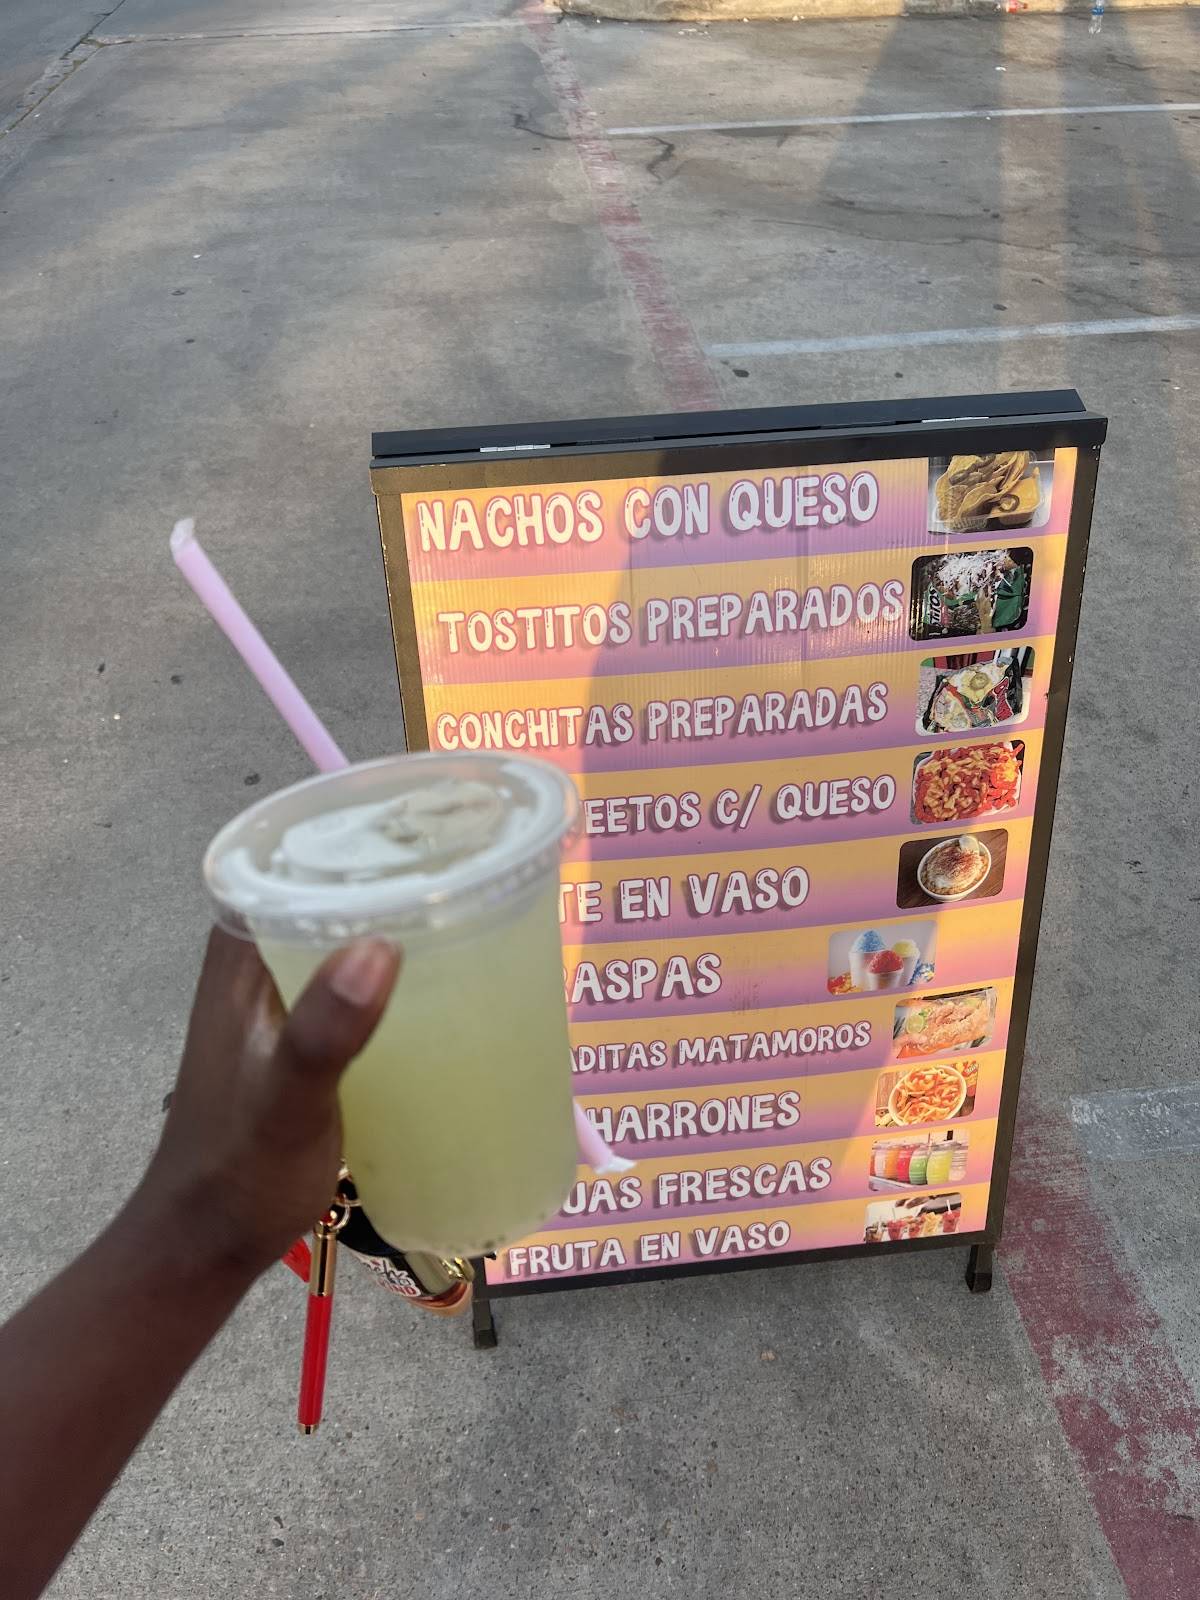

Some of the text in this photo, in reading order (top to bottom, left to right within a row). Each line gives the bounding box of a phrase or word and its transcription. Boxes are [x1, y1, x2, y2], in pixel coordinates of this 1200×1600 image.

[416, 470, 880, 553] NACHOS CON QUESO
[437, 580, 904, 654] TOSTITOS PREPARADOS
[435, 682, 889, 751] CONCHITAS PREPARADAS
[583, 774, 897, 835] EETOS C/ QUESO
[558, 866, 810, 923] TE EN VASO
[563, 953, 722, 1004] ASPAS
[678, 1020, 872, 1066] MATAMOROS
[585, 1090, 801, 1144] HARRONES
[560, 1157, 833, 1215] UAS FRESCAS
[508, 1220, 792, 1277] FRUTA EN VASO
